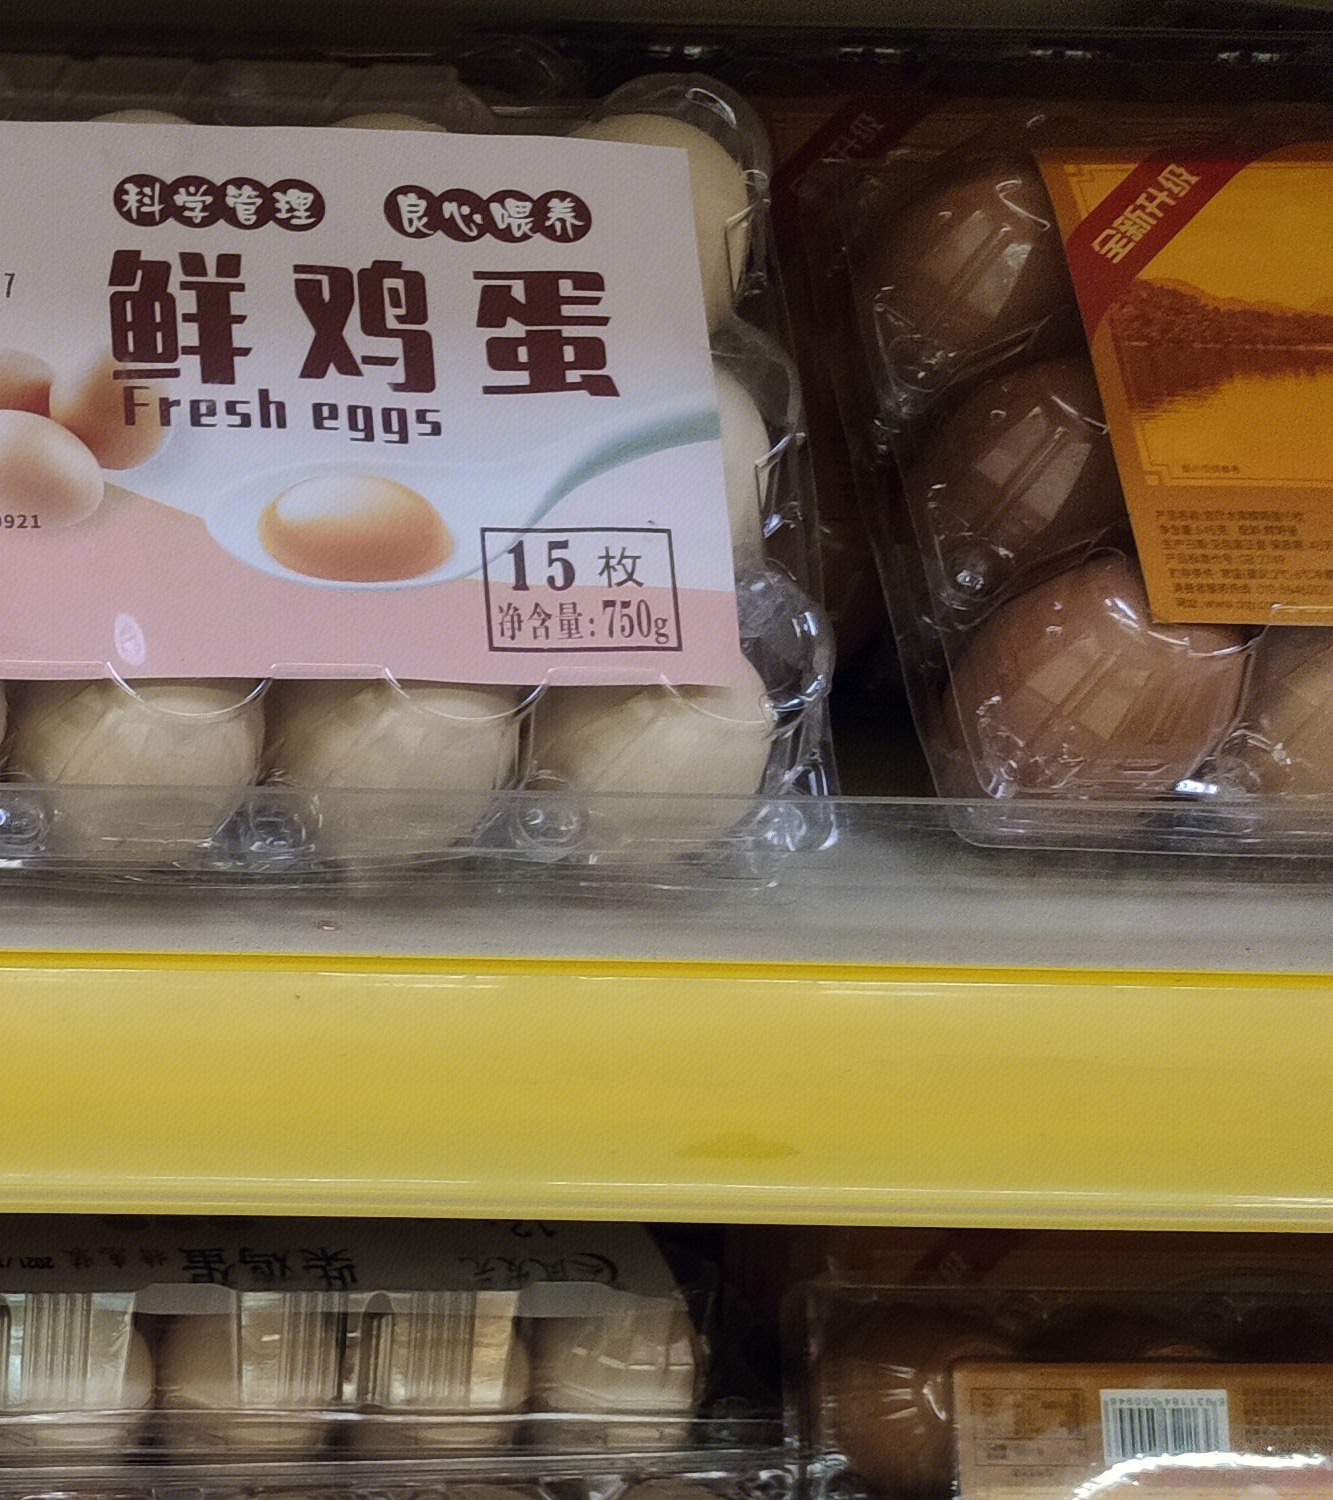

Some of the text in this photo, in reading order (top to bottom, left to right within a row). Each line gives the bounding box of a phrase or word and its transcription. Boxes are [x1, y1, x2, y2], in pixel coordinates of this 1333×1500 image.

[119, 181, 587, 238] 科学管理 良心喂养
[1091, 163, 1201, 264] 全新升级
[108, 250, 620, 398] 鲜鸡蛋
[123, 386, 442, 444] Fresh eggs
